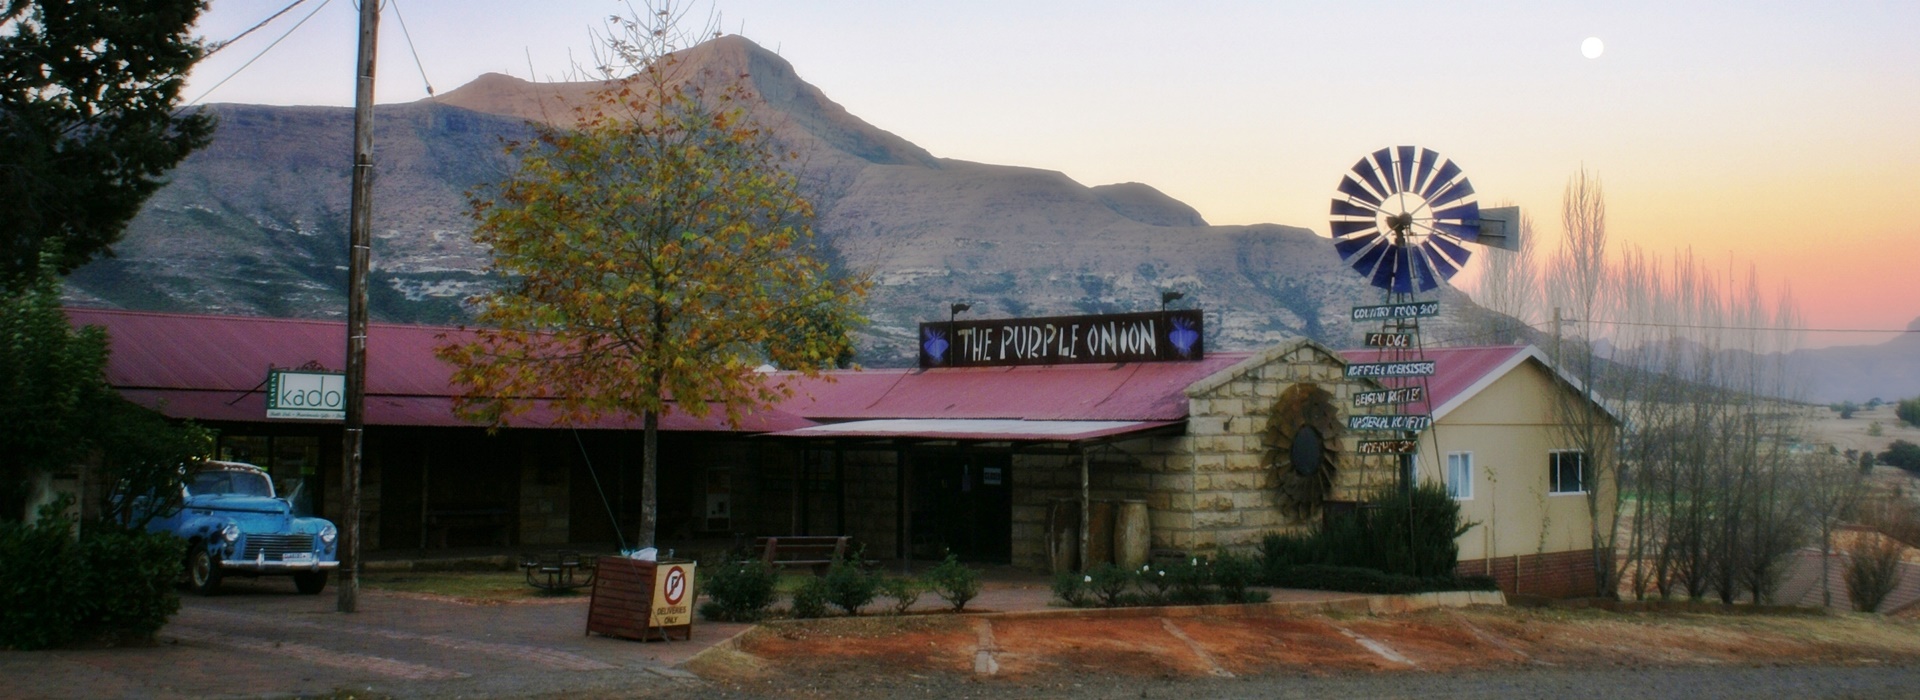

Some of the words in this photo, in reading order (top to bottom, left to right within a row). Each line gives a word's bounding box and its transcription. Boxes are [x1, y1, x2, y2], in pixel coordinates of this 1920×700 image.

[1354, 306, 1391, 319] COUNTRY
[1394, 305, 1418, 317] FOOD
[957, 326, 993, 362] THE
[999, 323, 1080, 360] PURPLE
[1370, 334, 1409, 347] FUDGE
[281, 374, 341, 407] kado
[657, 606, 687, 616] DELIVERIES
